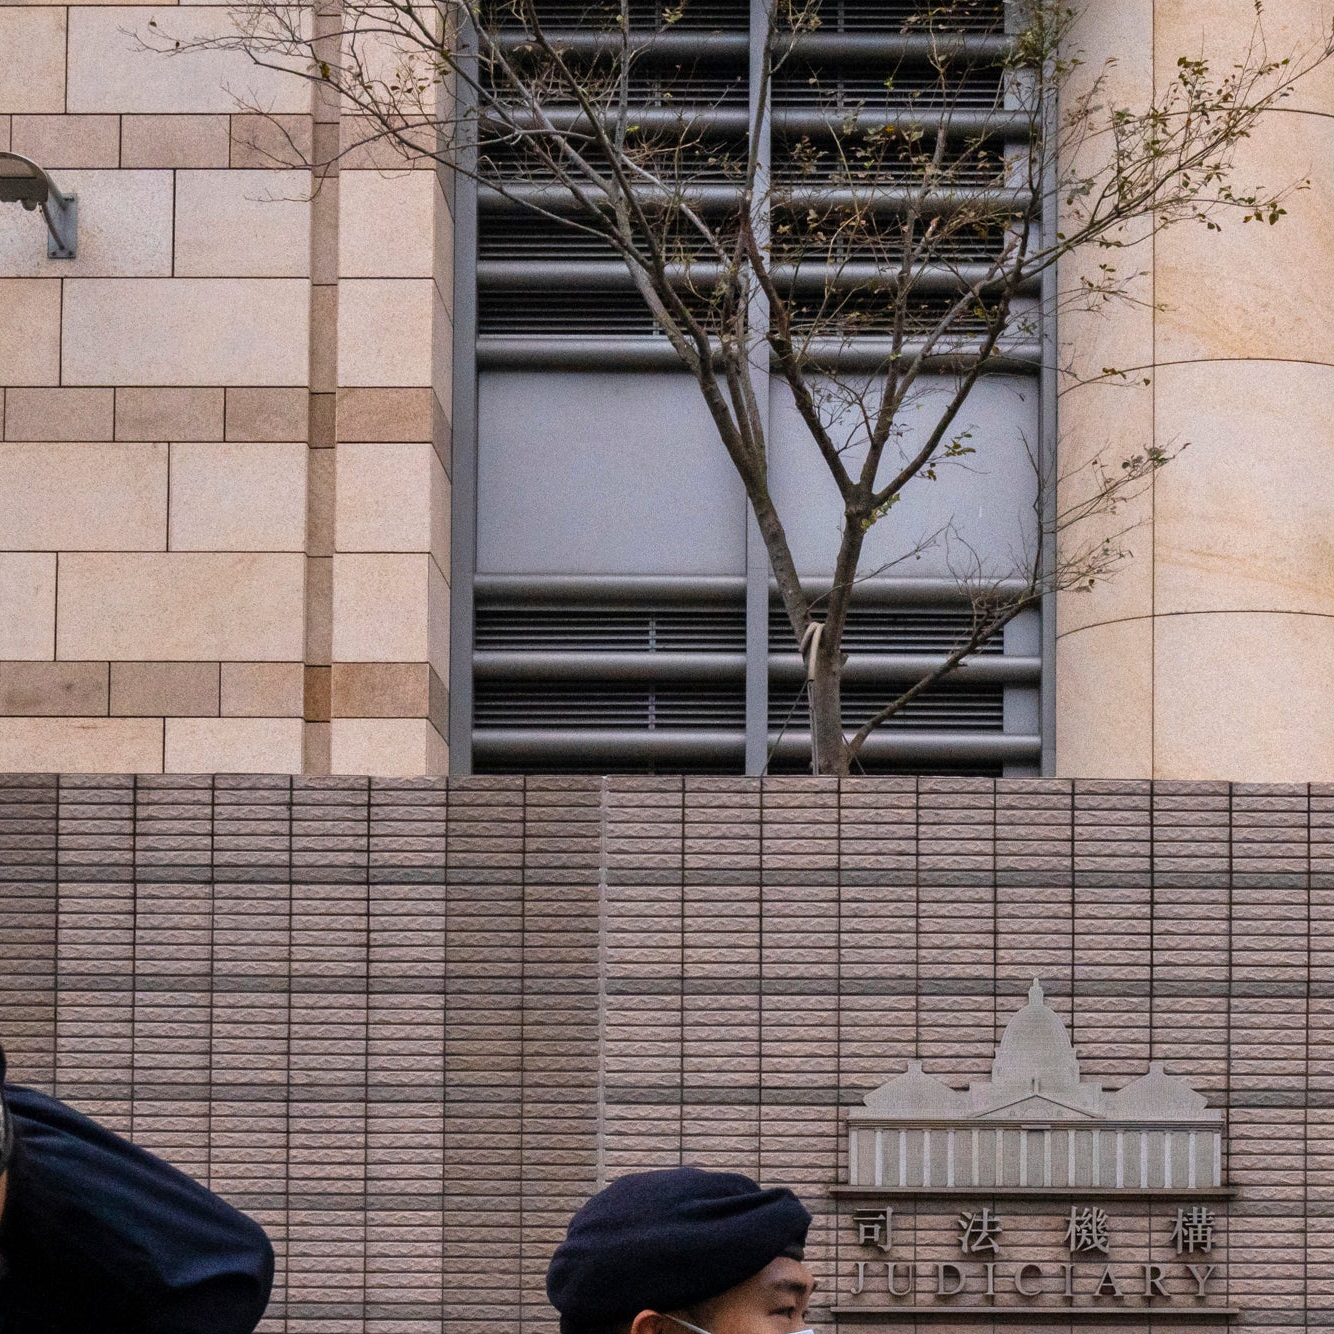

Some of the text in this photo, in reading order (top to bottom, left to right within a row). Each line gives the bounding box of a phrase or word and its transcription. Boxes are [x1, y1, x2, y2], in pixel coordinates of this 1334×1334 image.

[853, 1206, 1216, 1254] 司法機構
[851, 1262, 1216, 1297] JUDICIARY
